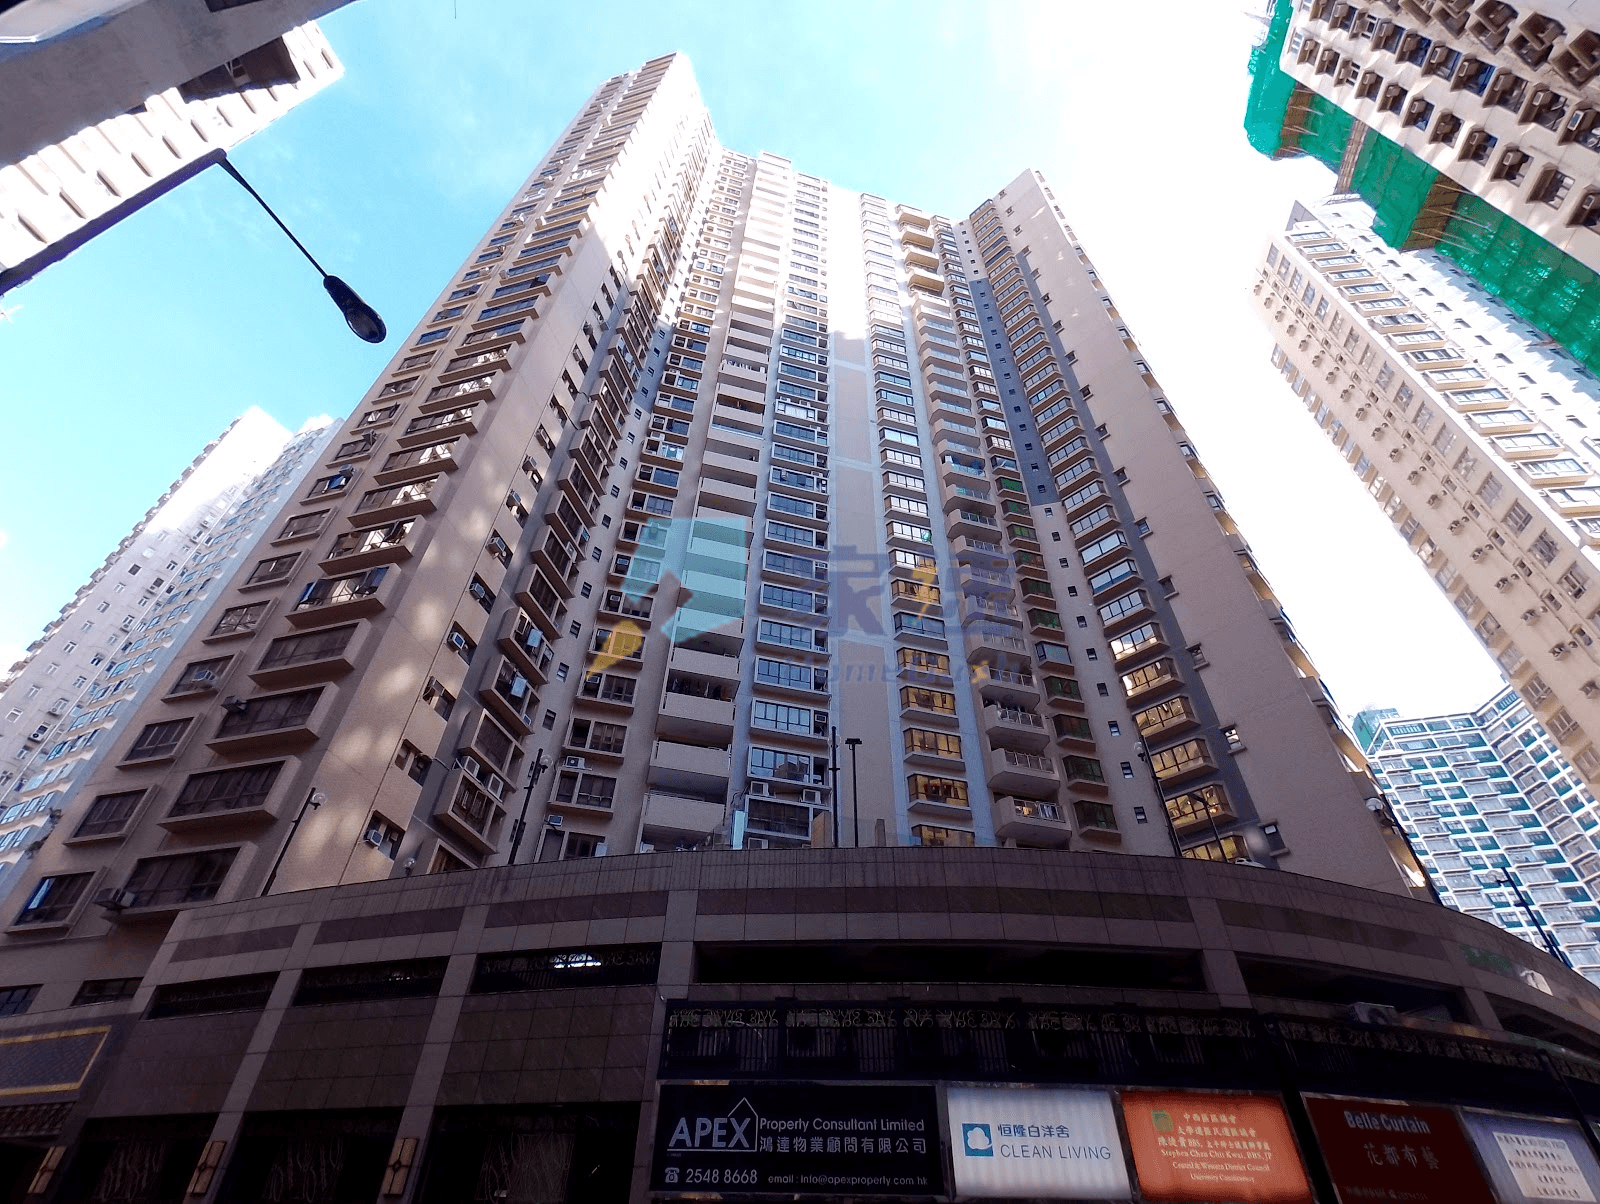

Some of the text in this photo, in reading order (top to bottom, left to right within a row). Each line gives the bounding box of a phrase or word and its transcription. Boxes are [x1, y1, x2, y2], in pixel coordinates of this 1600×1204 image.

[760, 1118, 925, 1132] Property Consultant Limited
[1343, 1110, 1431, 1134] Belle Curtain
[669, 1117, 750, 1148] APEX
[759, 1136, 927, 1154] 鴻達物業顧問有限公司
[1000, 1144, 1111, 1160] CLEAN LIVING
[685, 1169, 757, 1184] 2548 8668
